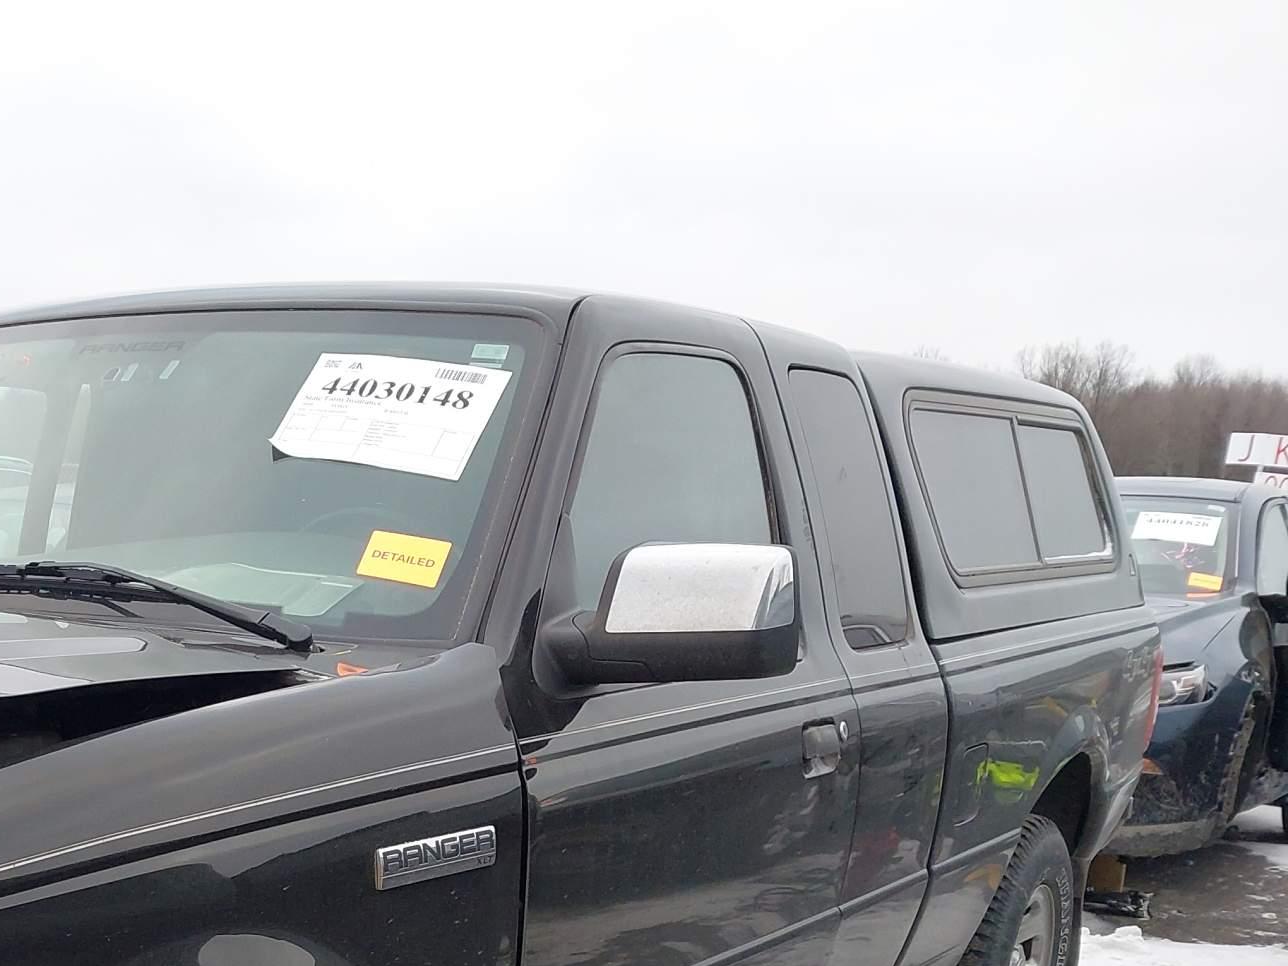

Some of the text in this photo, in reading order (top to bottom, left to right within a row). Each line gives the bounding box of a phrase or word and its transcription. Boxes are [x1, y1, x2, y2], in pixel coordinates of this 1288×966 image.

[321, 376, 474, 410] 44030148
[371, 549, 436, 568] DETAILED
[382, 829, 495, 873] RANGER
[476, 856, 493, 865] XLT
